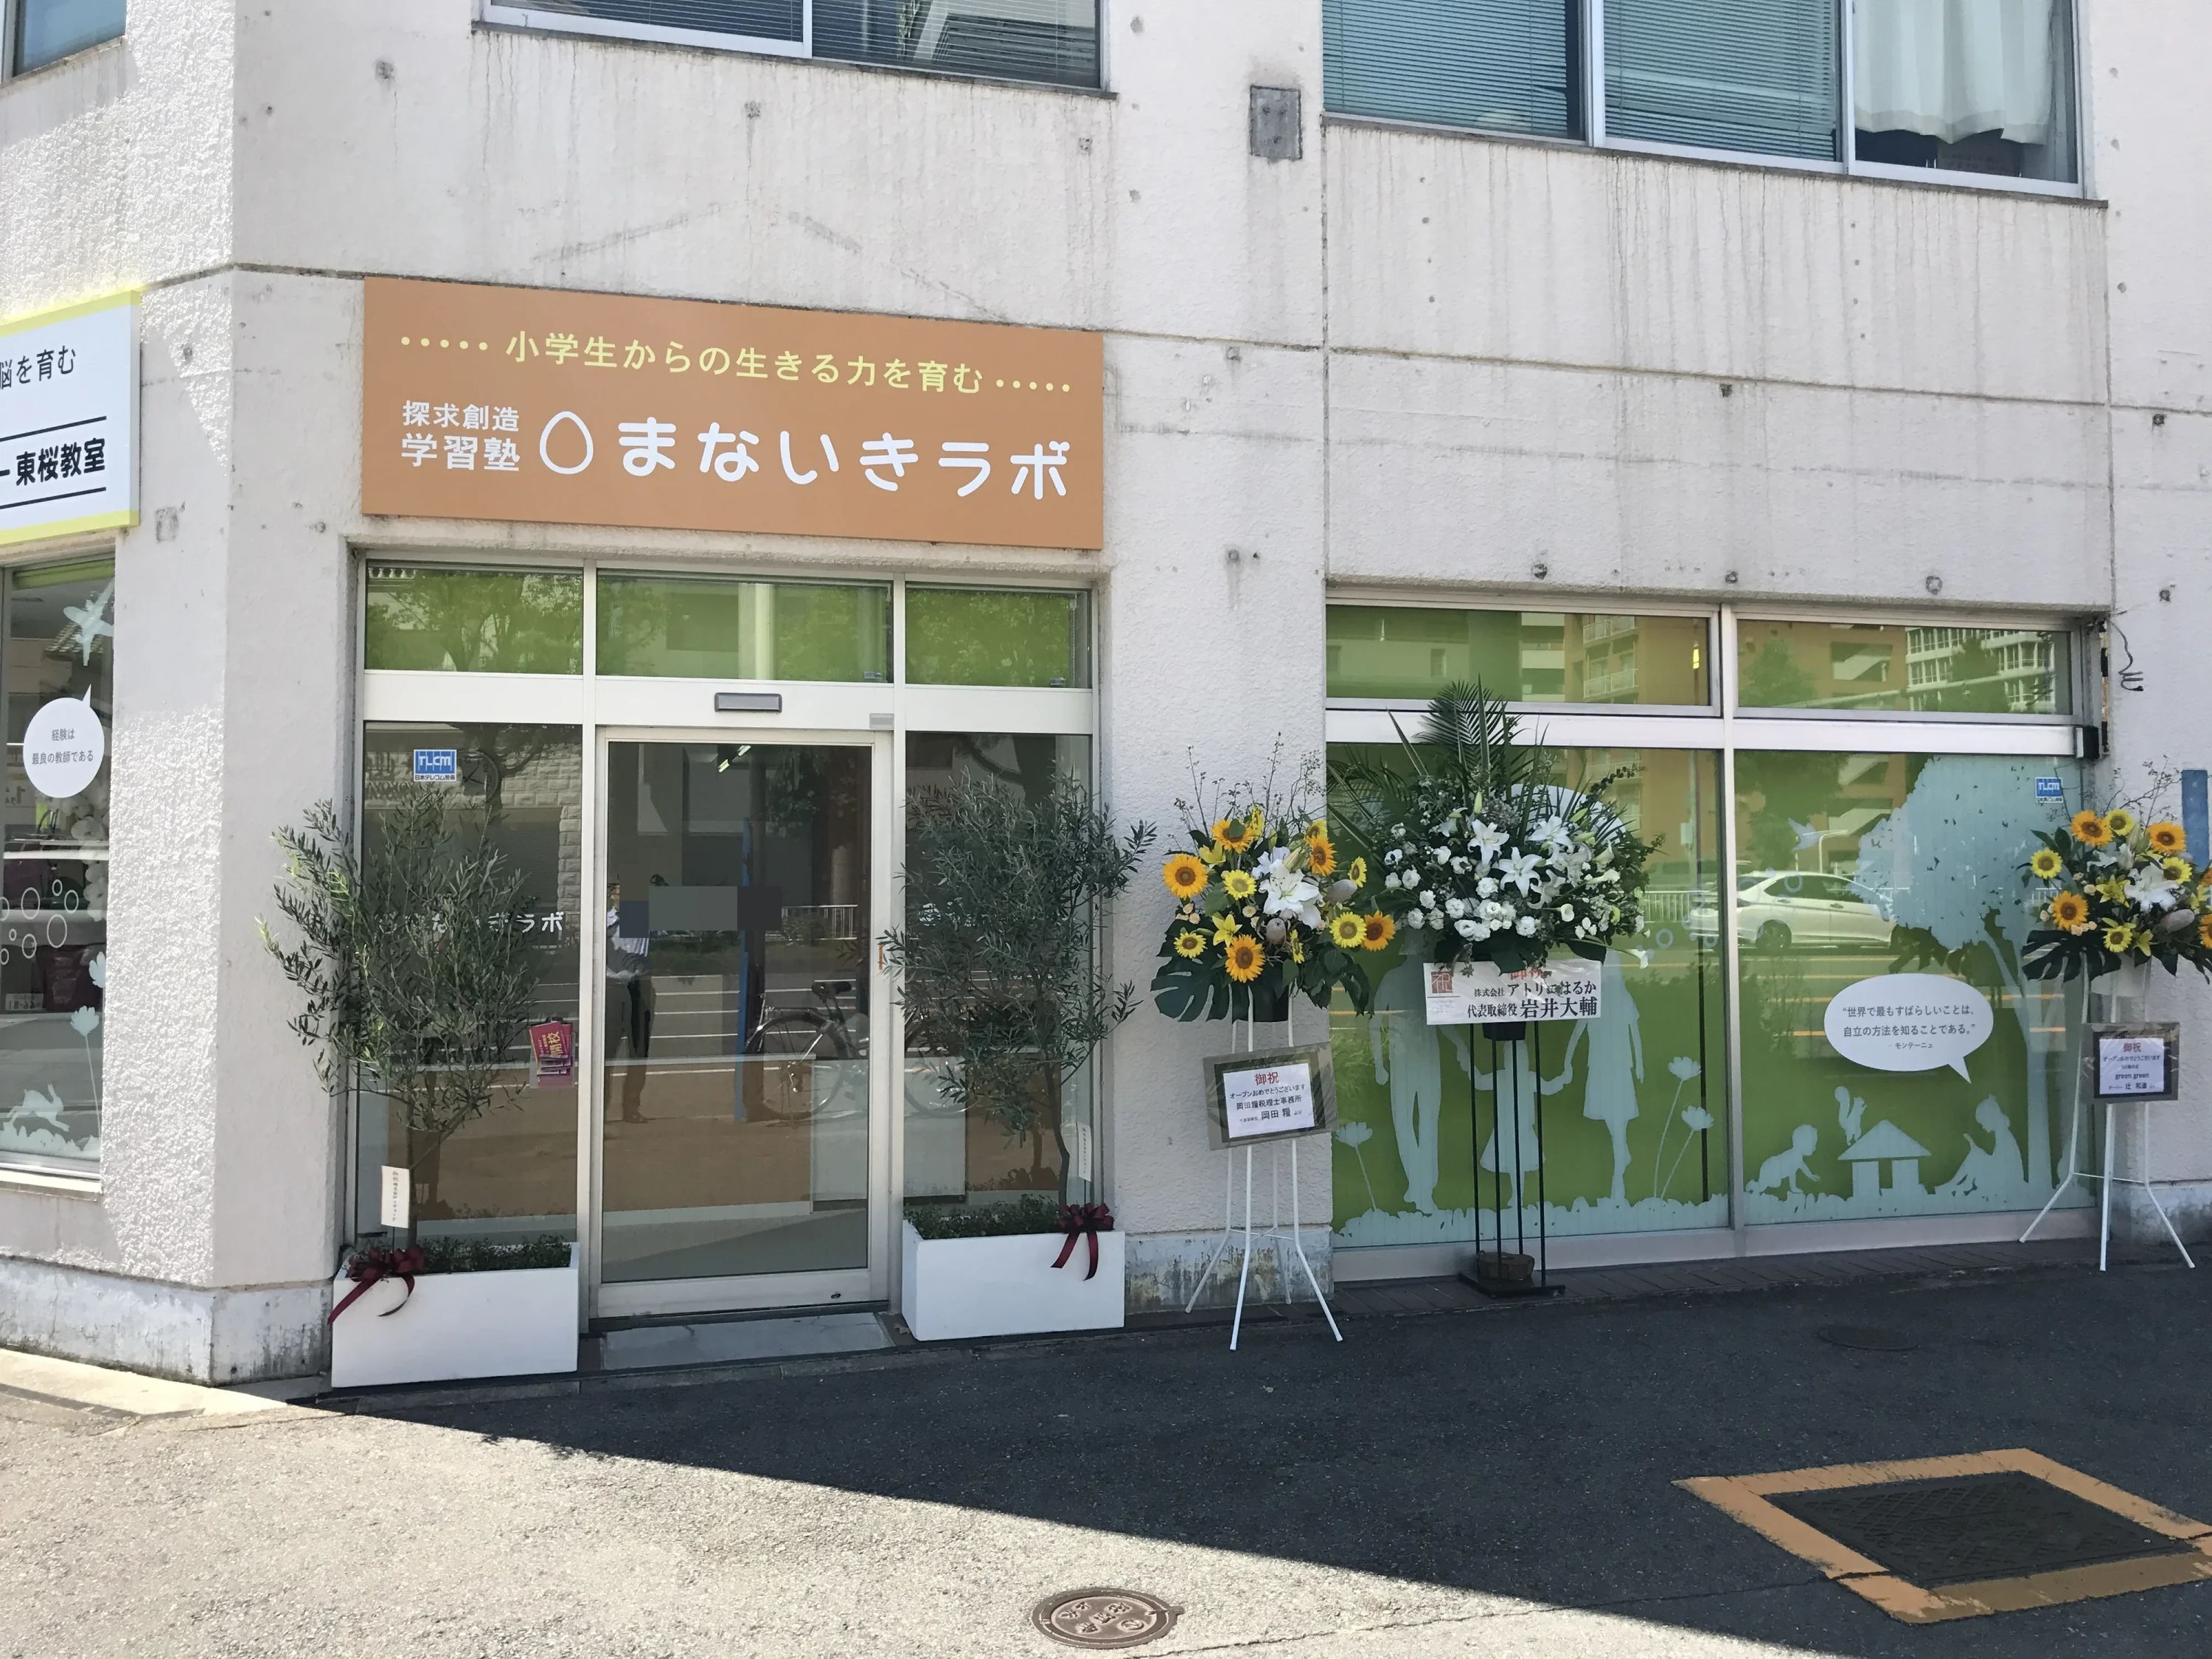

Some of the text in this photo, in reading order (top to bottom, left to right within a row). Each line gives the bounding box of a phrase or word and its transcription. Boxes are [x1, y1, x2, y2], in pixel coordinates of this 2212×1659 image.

[506, 330, 983, 394] 小学生からの生きる力を育む
[403, 400, 519, 431] 探求創造
[401, 433, 521, 472] 学習塾
[618, 417, 1071, 500] まないきラボ
[52, 728, 74, 741] 経験は
[32, 750, 94, 765] 最良の教師である
[418, 755, 452, 766] TLCM
[1255, 1071, 1279, 1086] 御祝
[1230, 1084, 1306, 1099] オープンおめでとうございます
[1261, 1110, 1279, 1120] 岡田
